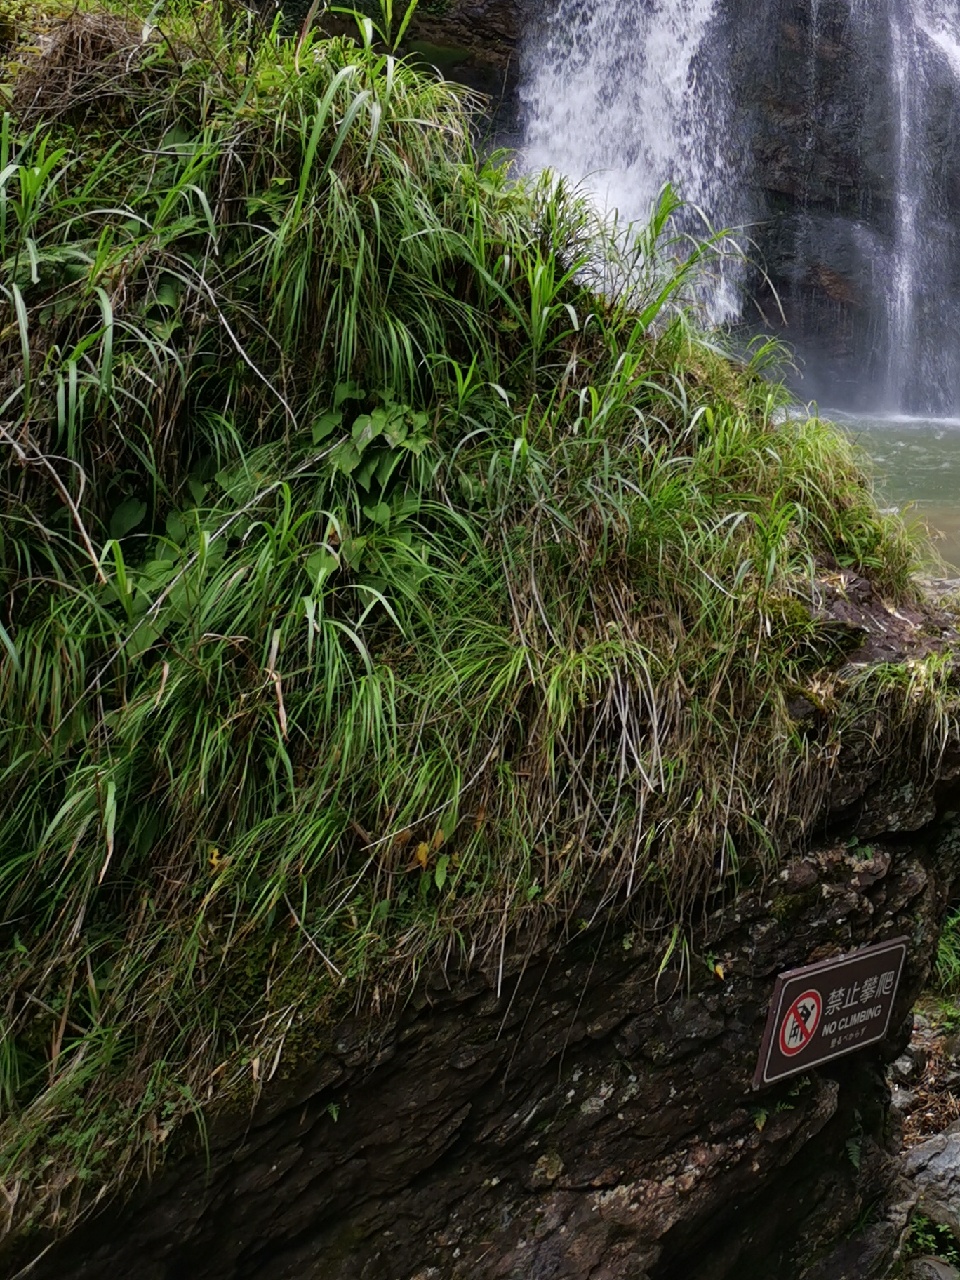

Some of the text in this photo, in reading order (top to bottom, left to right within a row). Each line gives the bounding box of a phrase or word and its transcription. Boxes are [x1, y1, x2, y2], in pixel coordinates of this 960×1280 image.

[825, 970, 895, 1016] 禁止攀爬
[822, 1005, 882, 1036] NO CLIMBING
